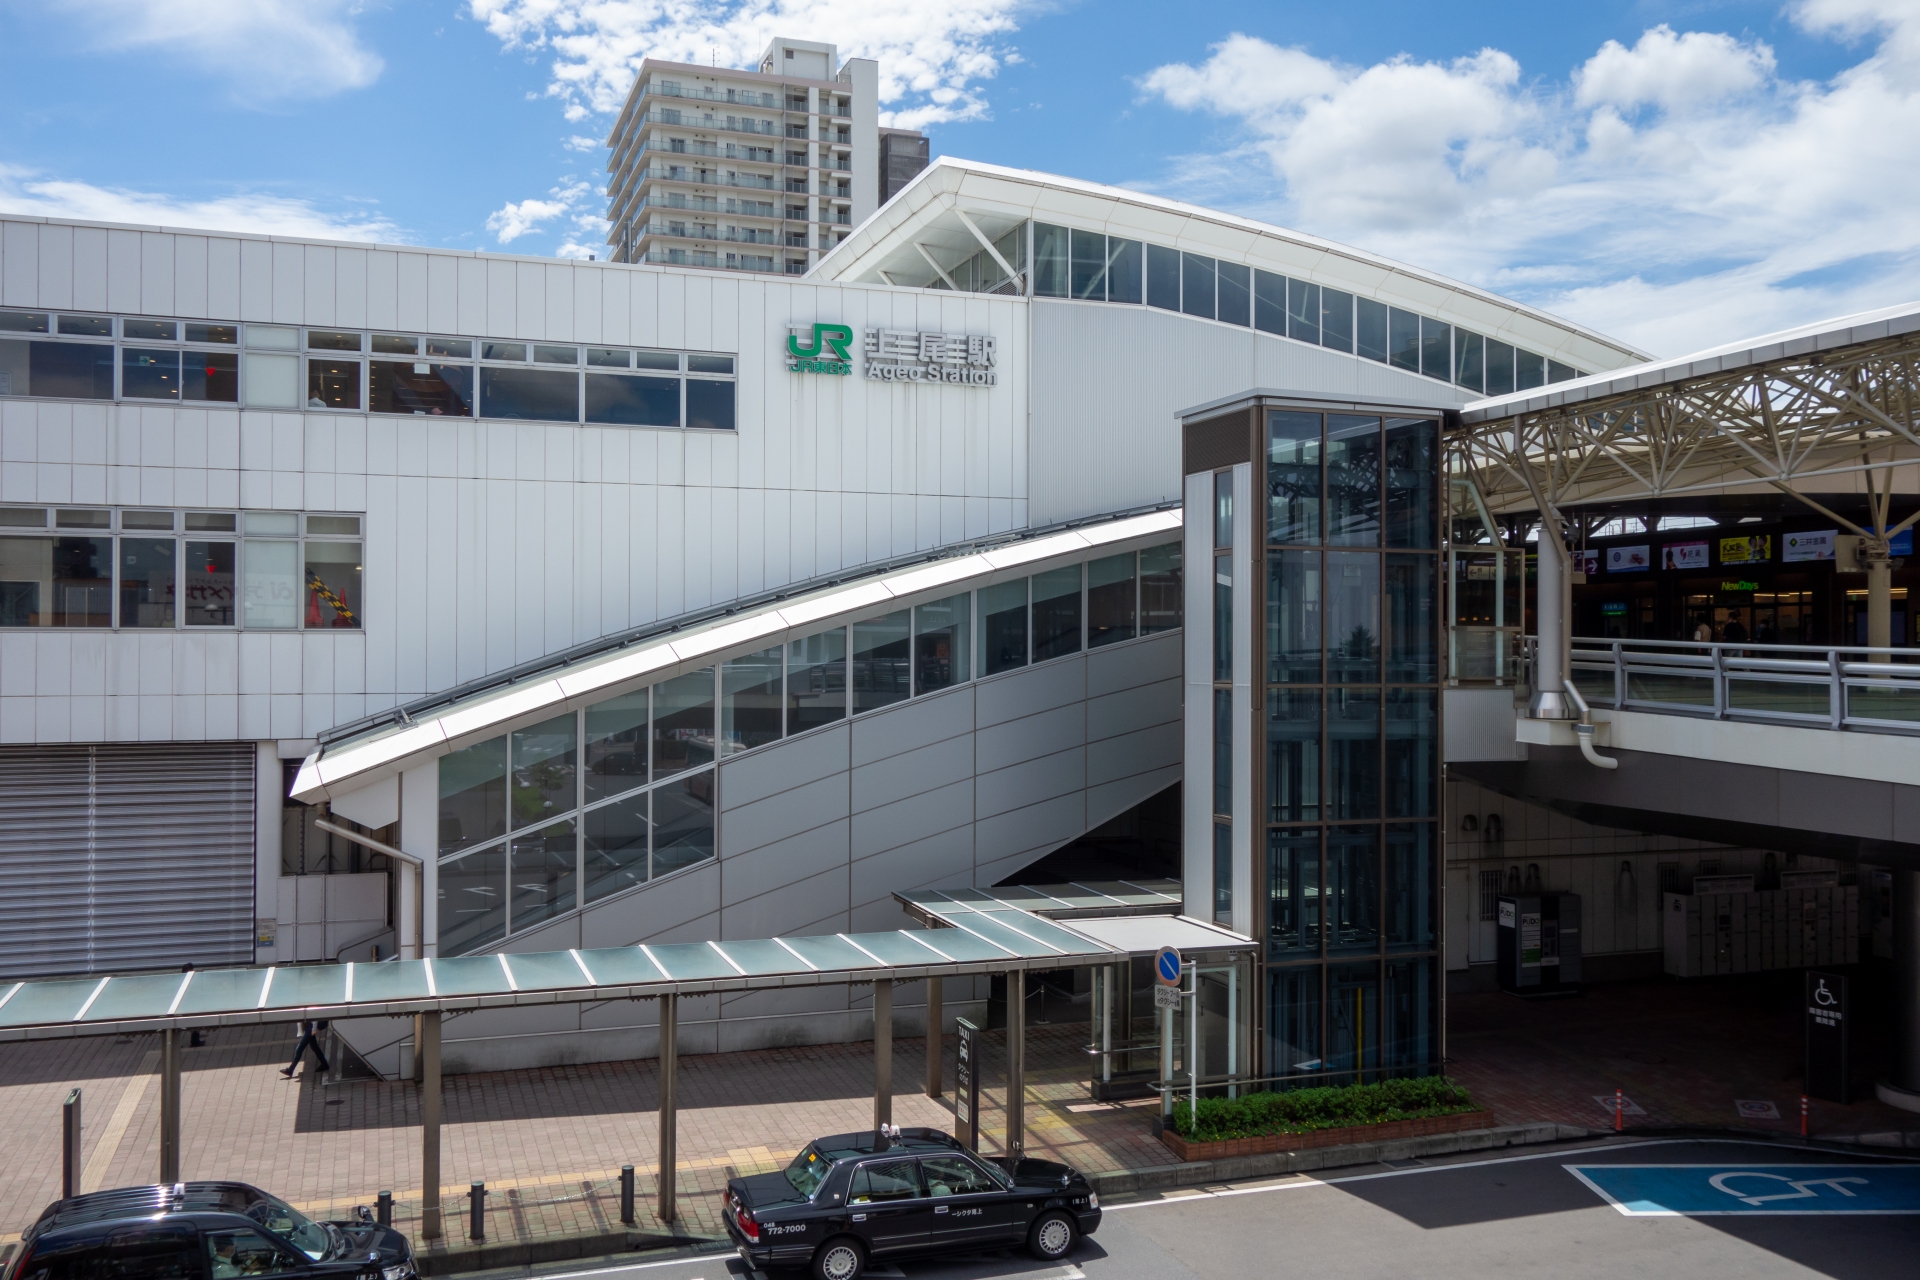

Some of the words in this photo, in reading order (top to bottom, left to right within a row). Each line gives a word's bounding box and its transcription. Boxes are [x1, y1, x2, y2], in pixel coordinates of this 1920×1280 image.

[788, 322, 853, 361] JR
[866, 328, 997, 367] 上尾駅
[790, 360, 852, 376] JR東日本
[868, 361, 921, 382] Ageo
[927, 362, 998, 385] Station
[1721, 580, 1759, 591] NewDays
[1522, 917, 1540, 925] PUDO
[958, 1025, 970, 1041] TAXI
[768, 1224, 806, 1236] 772-7000
